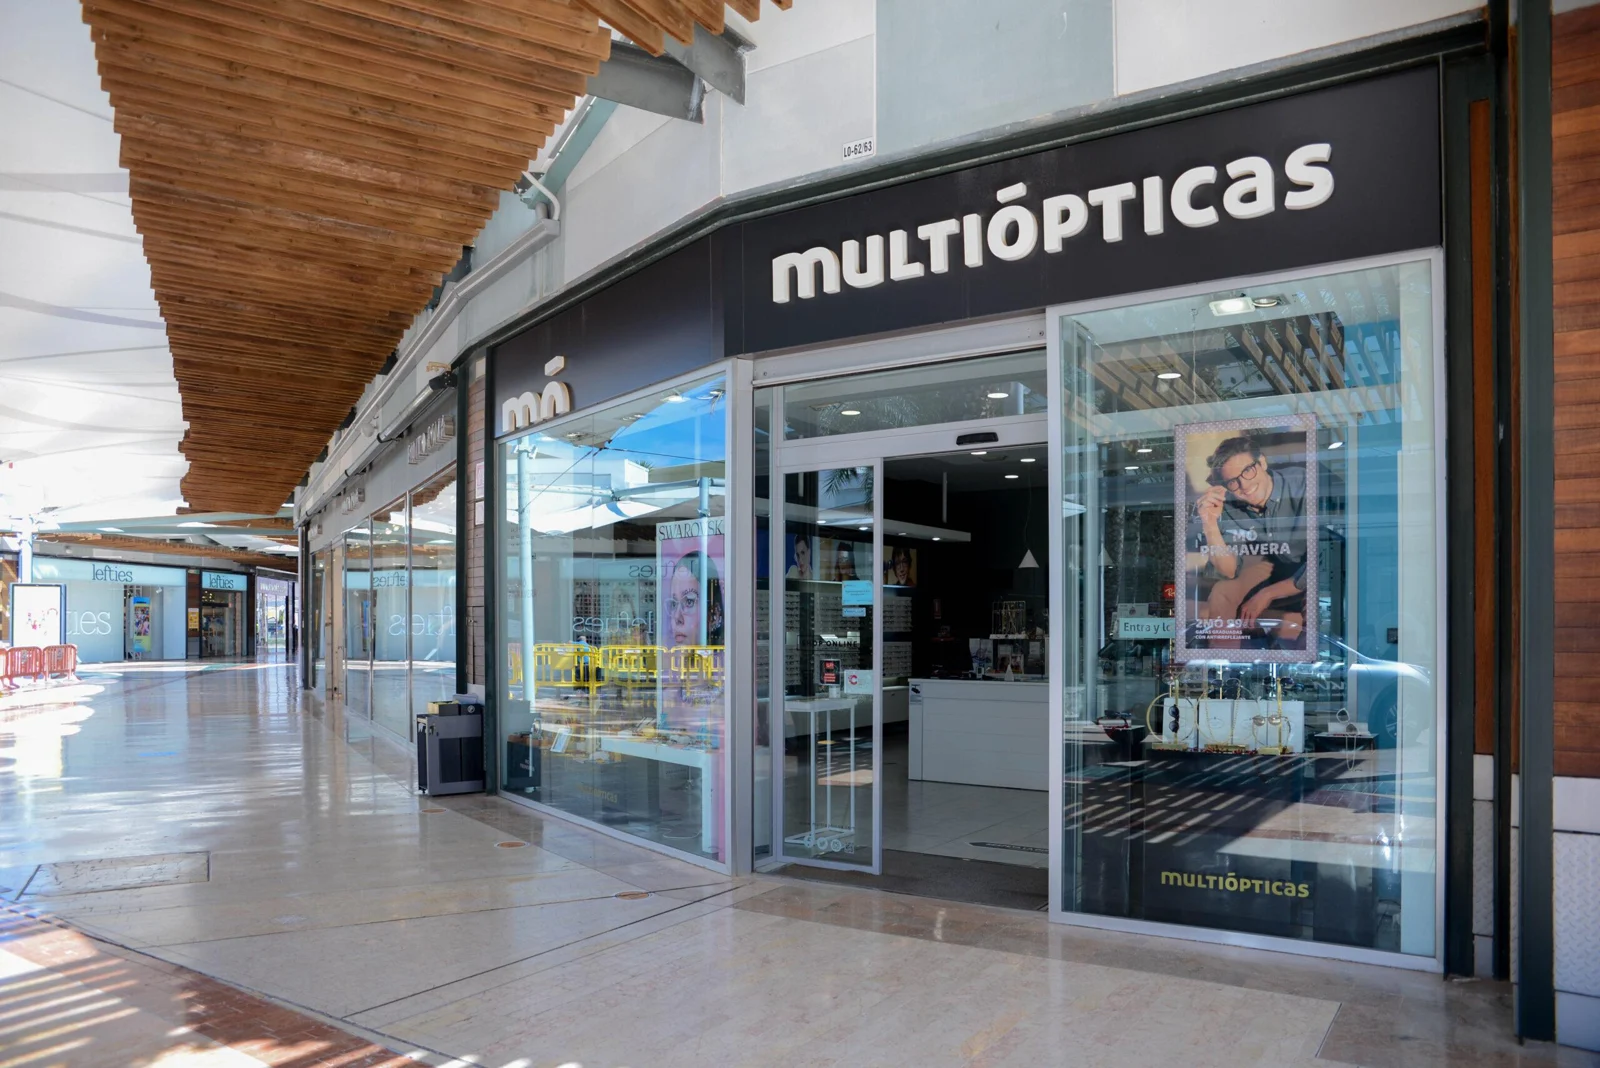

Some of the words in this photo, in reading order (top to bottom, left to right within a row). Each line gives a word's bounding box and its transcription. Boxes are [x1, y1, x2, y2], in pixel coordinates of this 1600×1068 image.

[659, 520, 724, 540] SWAROVSK
[92, 564, 133, 583] lefties
[208, 573, 234, 589] lefties
[1123, 622, 1150, 632] Entra
[1153, 624, 1160, 635] y
